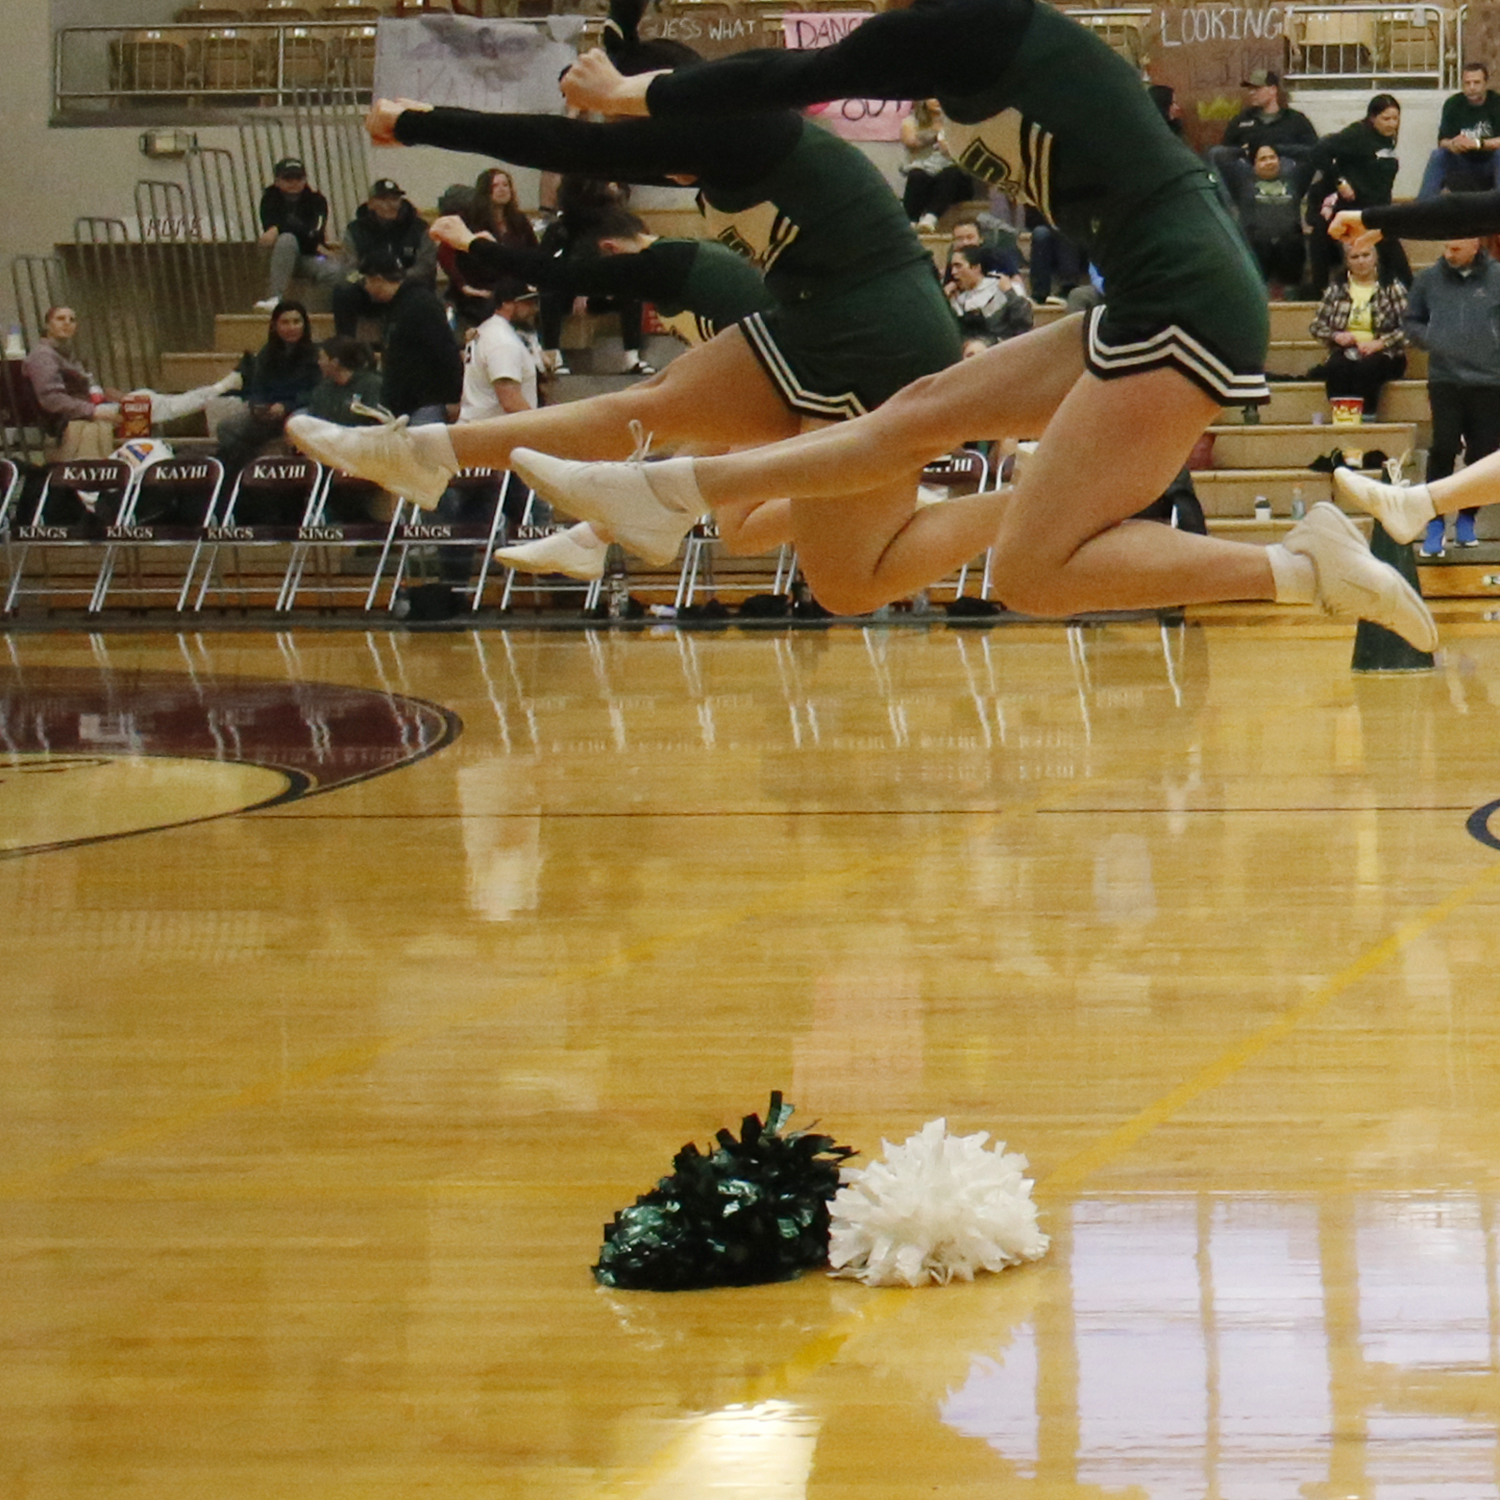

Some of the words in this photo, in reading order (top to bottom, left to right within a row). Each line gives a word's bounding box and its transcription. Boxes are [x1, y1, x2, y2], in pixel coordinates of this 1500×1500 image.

[708, 16, 757, 42] WHAT
[1160, 7, 1283, 48] LOOKING
[63, 466, 118, 481] KAYHI
[155, 465, 208, 480] KAYHI
[252, 464, 306, 479] KAYHI
[19, 526, 67, 539] KINGS
[107, 526, 153, 539] KINGS
[207, 526, 254, 540] KINGS
[298, 526, 344, 540] KINGS
[403, 525, 451, 538] KINGS
